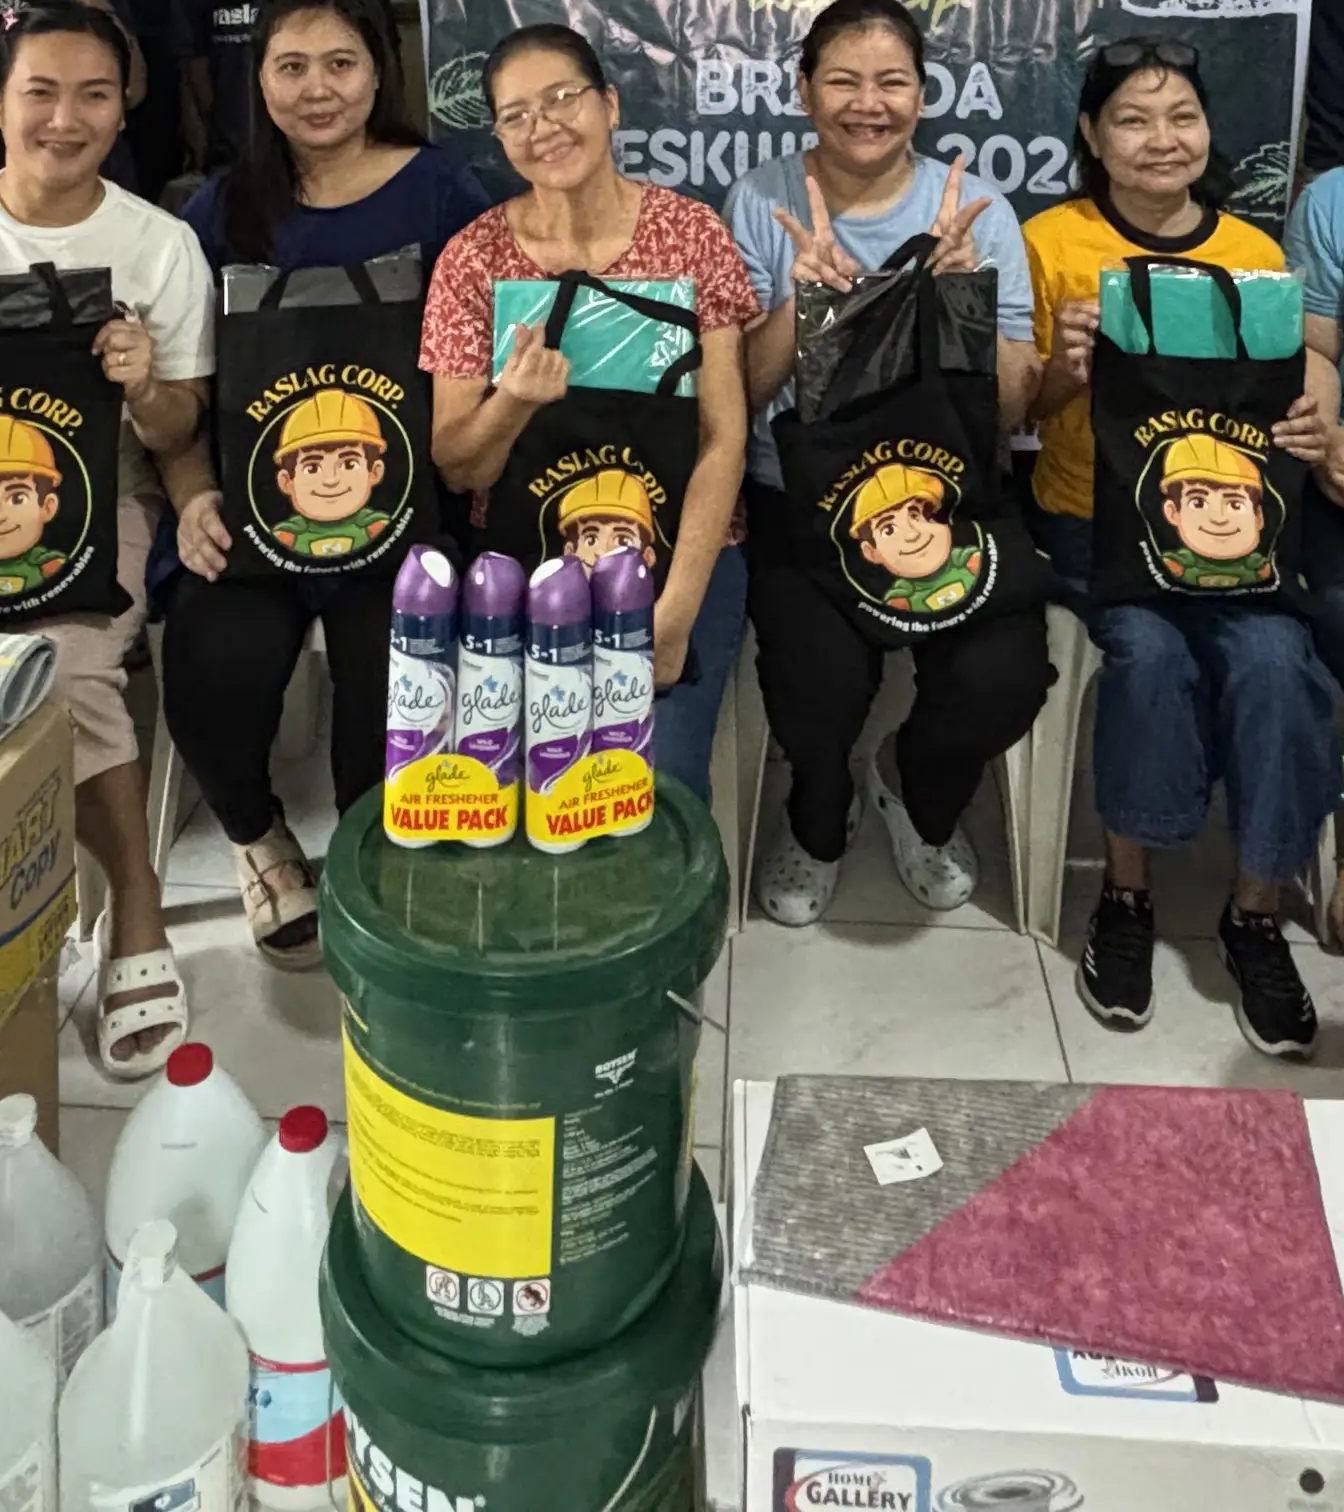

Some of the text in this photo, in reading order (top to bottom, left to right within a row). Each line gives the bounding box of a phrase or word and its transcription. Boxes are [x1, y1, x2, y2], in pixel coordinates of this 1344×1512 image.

[937, 133, 1082, 194] 202
[10, 387, 84, 437] CORP.
[246, 364, 406, 424] RASLAG CORP.
[528, 445, 617, 498] RASLAG
[897, 438, 966, 482] CORP.
[243, 523, 285, 570] powering
[285, 558, 303, 573] the
[14, 597, 40, 614] with
[40, 545, 96, 607] renewables
[858, 600, 910, 633] powering
[910, 619, 930, 633] the
[462, 682, 520, 725] glade
[530, 691, 589, 733] glade
[593, 677, 651, 717] glade
[426, 763, 471, 792] glade
[559, 778, 649, 811] AIR FRESHENER
[583, 757, 625, 792] glade
[390, 804, 508, 830] VALUE PACK
[400, 793, 499, 805] AIR FRESHENER
[546, 791, 653, 836] VALUE PACK
[807, 1482, 913, 1511] GALLERY
